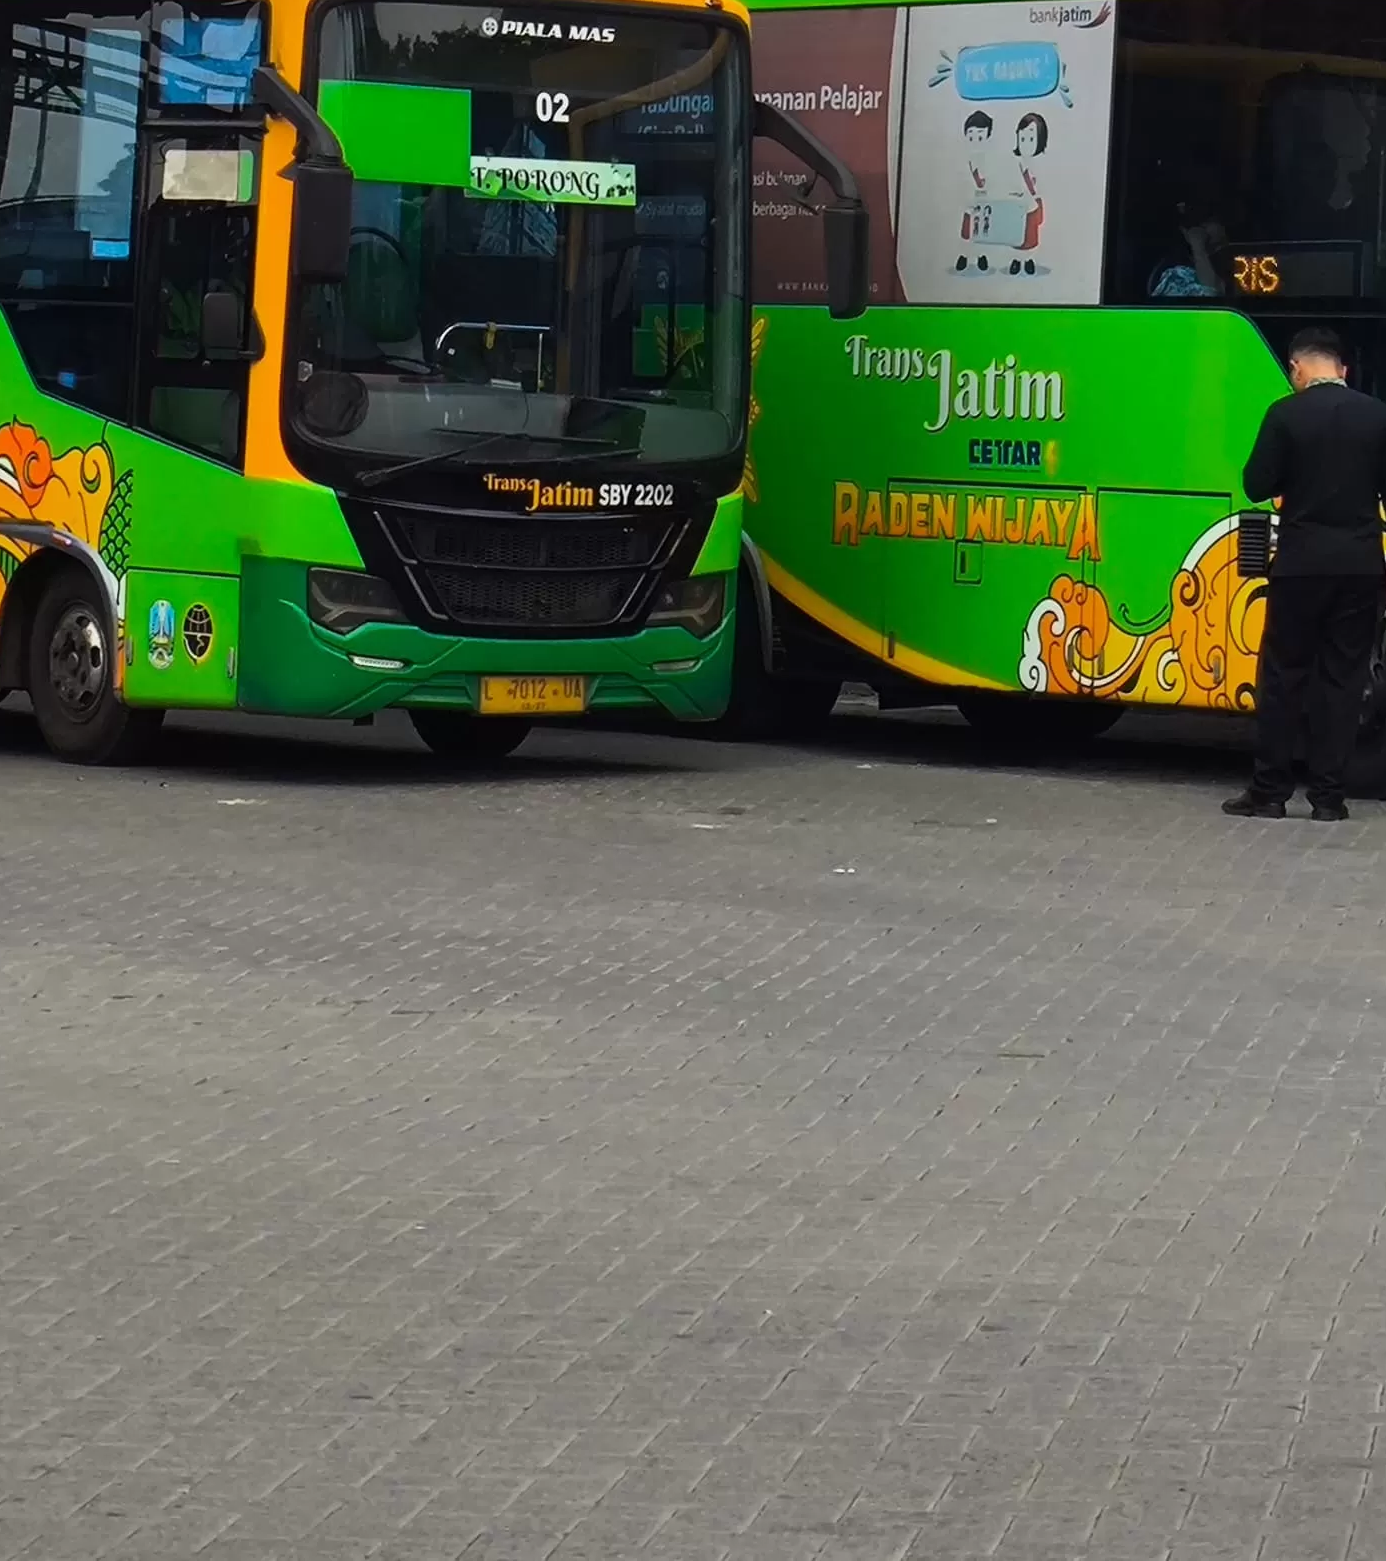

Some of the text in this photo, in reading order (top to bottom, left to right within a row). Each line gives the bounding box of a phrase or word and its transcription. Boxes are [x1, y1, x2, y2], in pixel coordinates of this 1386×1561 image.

[501, 20, 616, 43] PIALA MAS
[535, 91, 570, 123] 02
[820, 84, 883, 115] Pelajar
[471, 167, 601, 201] T. PORONG
[844, 334, 1067, 433] Trans Jatim
[482, 472, 674, 511] Trans Jatim SBY 2202
[831, 480, 1101, 562] RADEN WIJAYA
[484, 678, 582, 701] L 7012 UA
